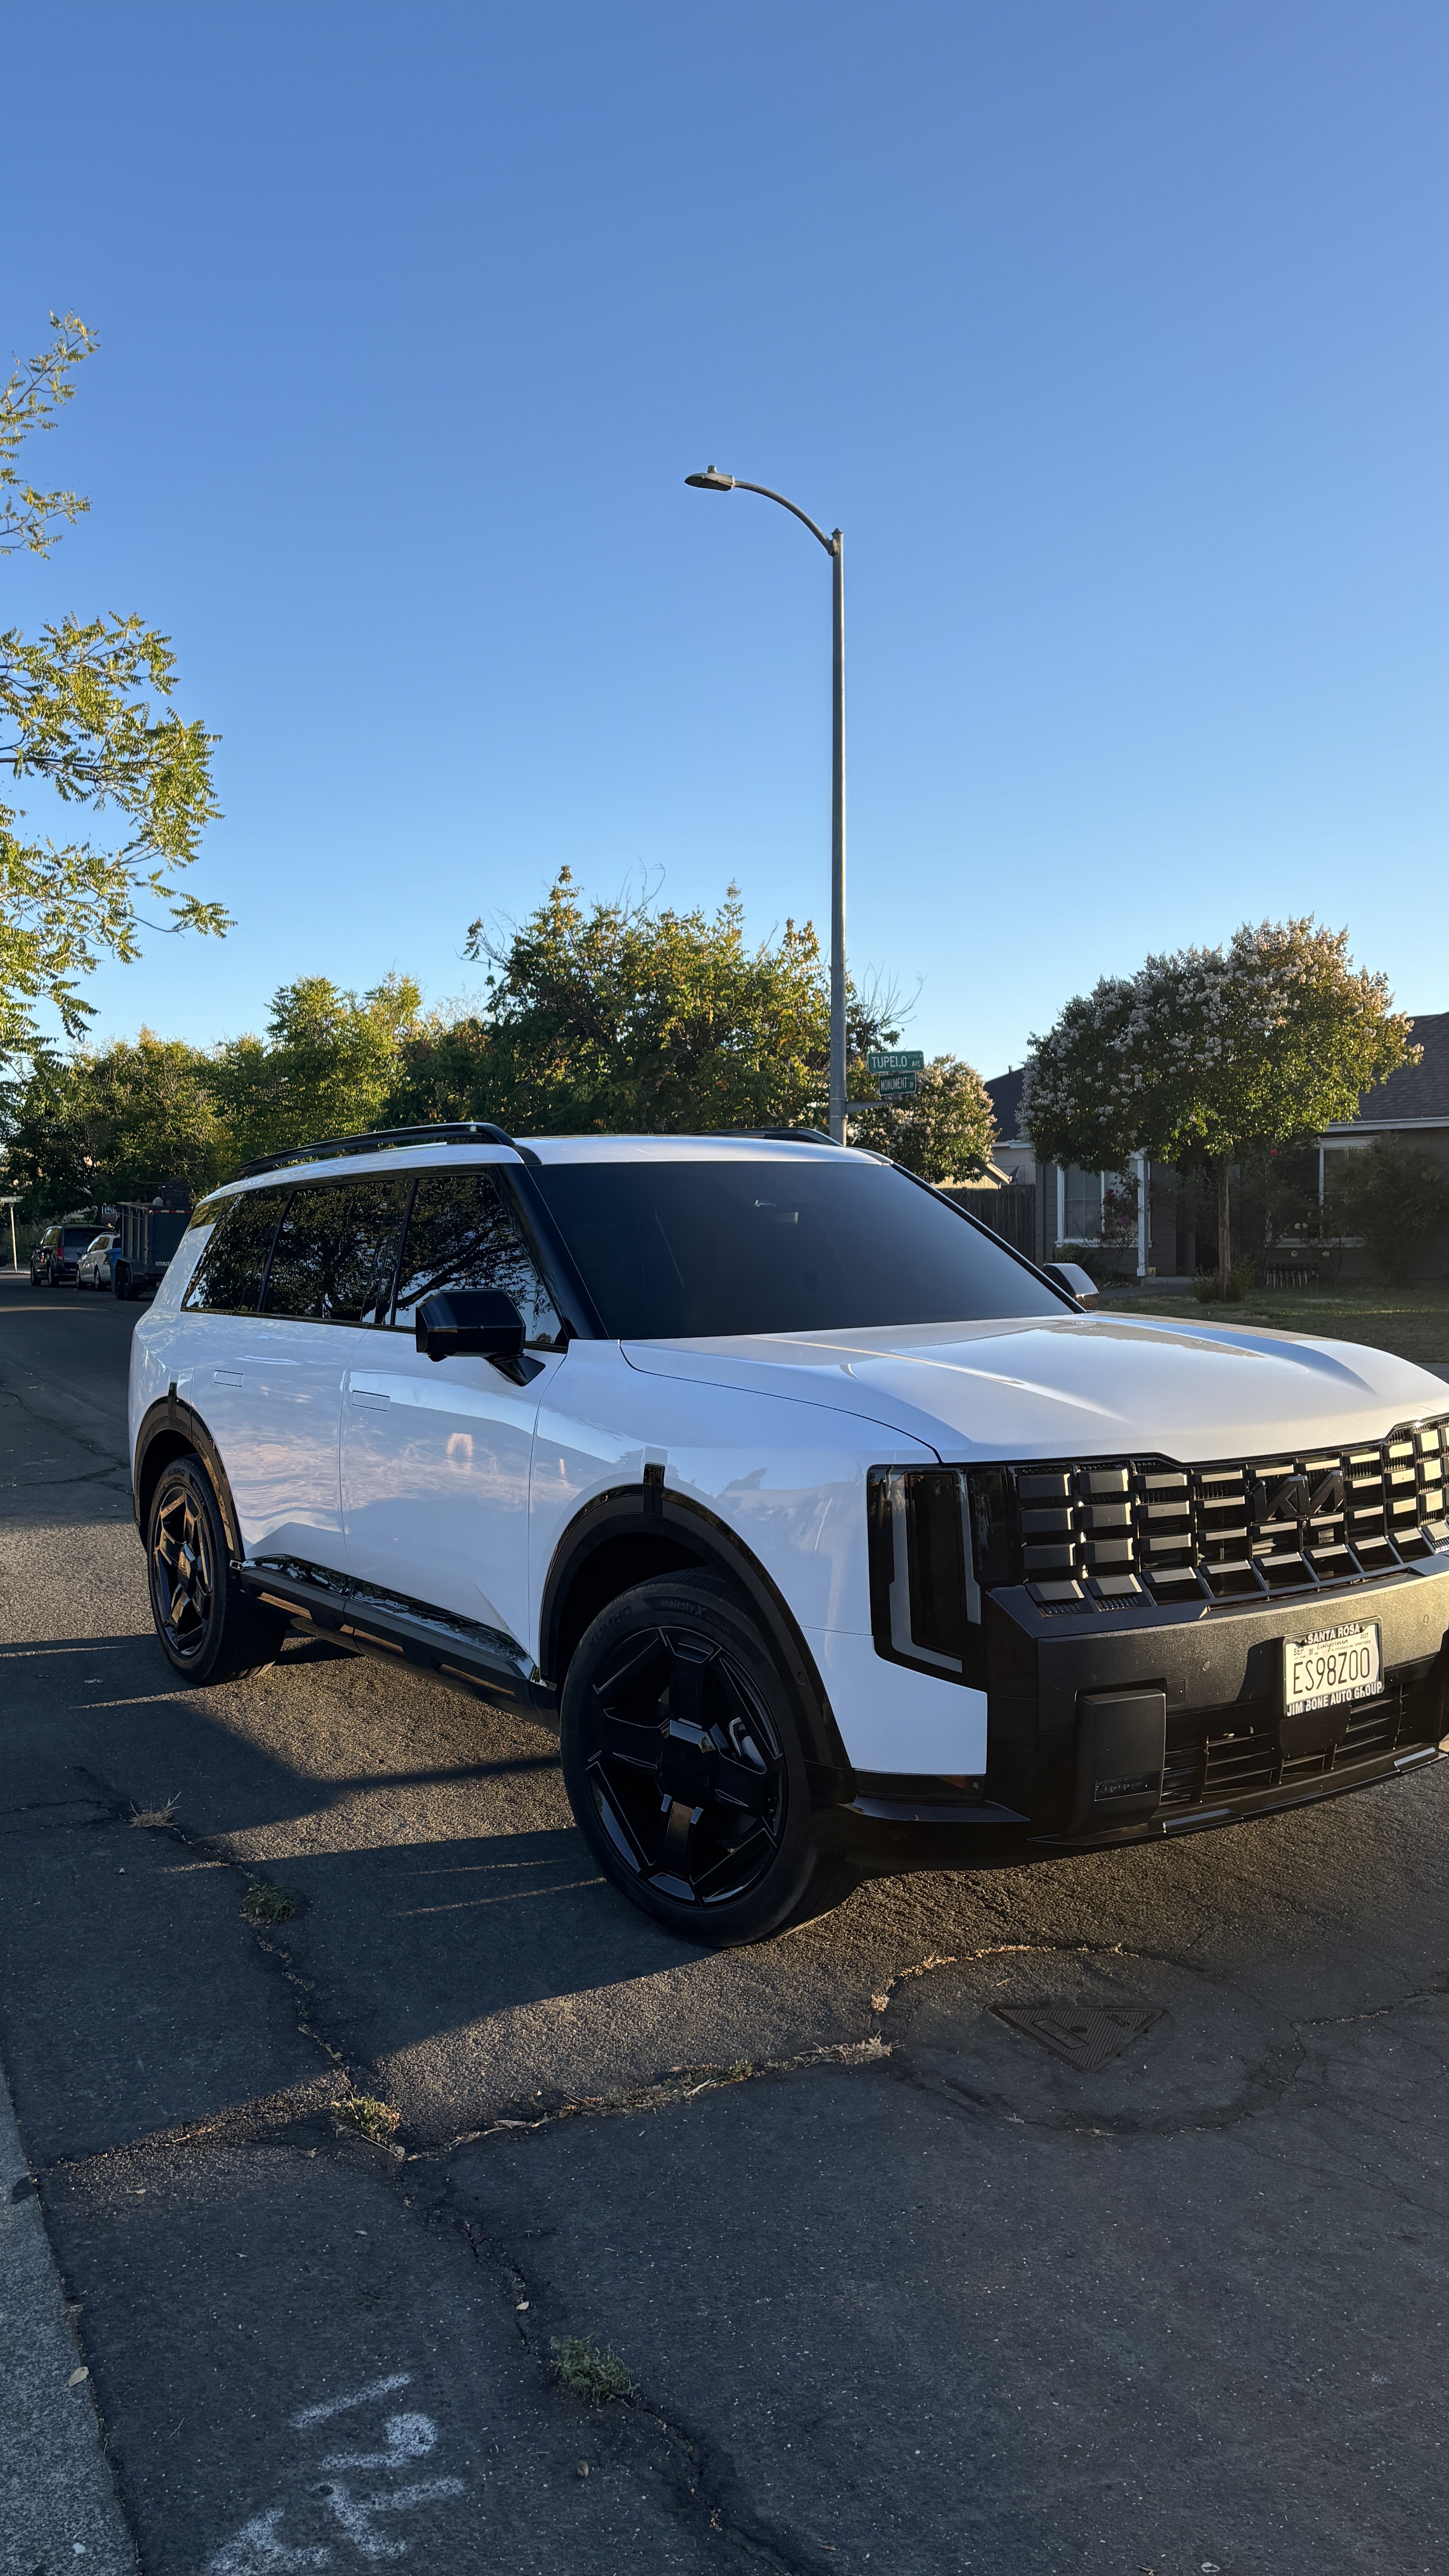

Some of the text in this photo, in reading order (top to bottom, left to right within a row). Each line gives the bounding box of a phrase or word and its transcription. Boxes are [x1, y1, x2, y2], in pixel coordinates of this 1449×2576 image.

[871, 1056, 907, 1068] TUPELO
[880, 1076, 907, 1091] MONUMENT
[168, 1467, 185, 1477] KUMHO
[661, 1599, 695, 1614] Majesty
[694, 1604, 707, 1618] X
[589, 1605, 633, 1648] KUMHO
[1308, 1623, 1360, 1644] SANTA ROSA
[1293, 1647, 1304, 1656] SEP
[1317, 1639, 1348, 1652] California
[1293, 1647, 1370, 1695] ES98Z00
[1287, 1682, 1383, 1717] JIM BONE AUTO GROUP
